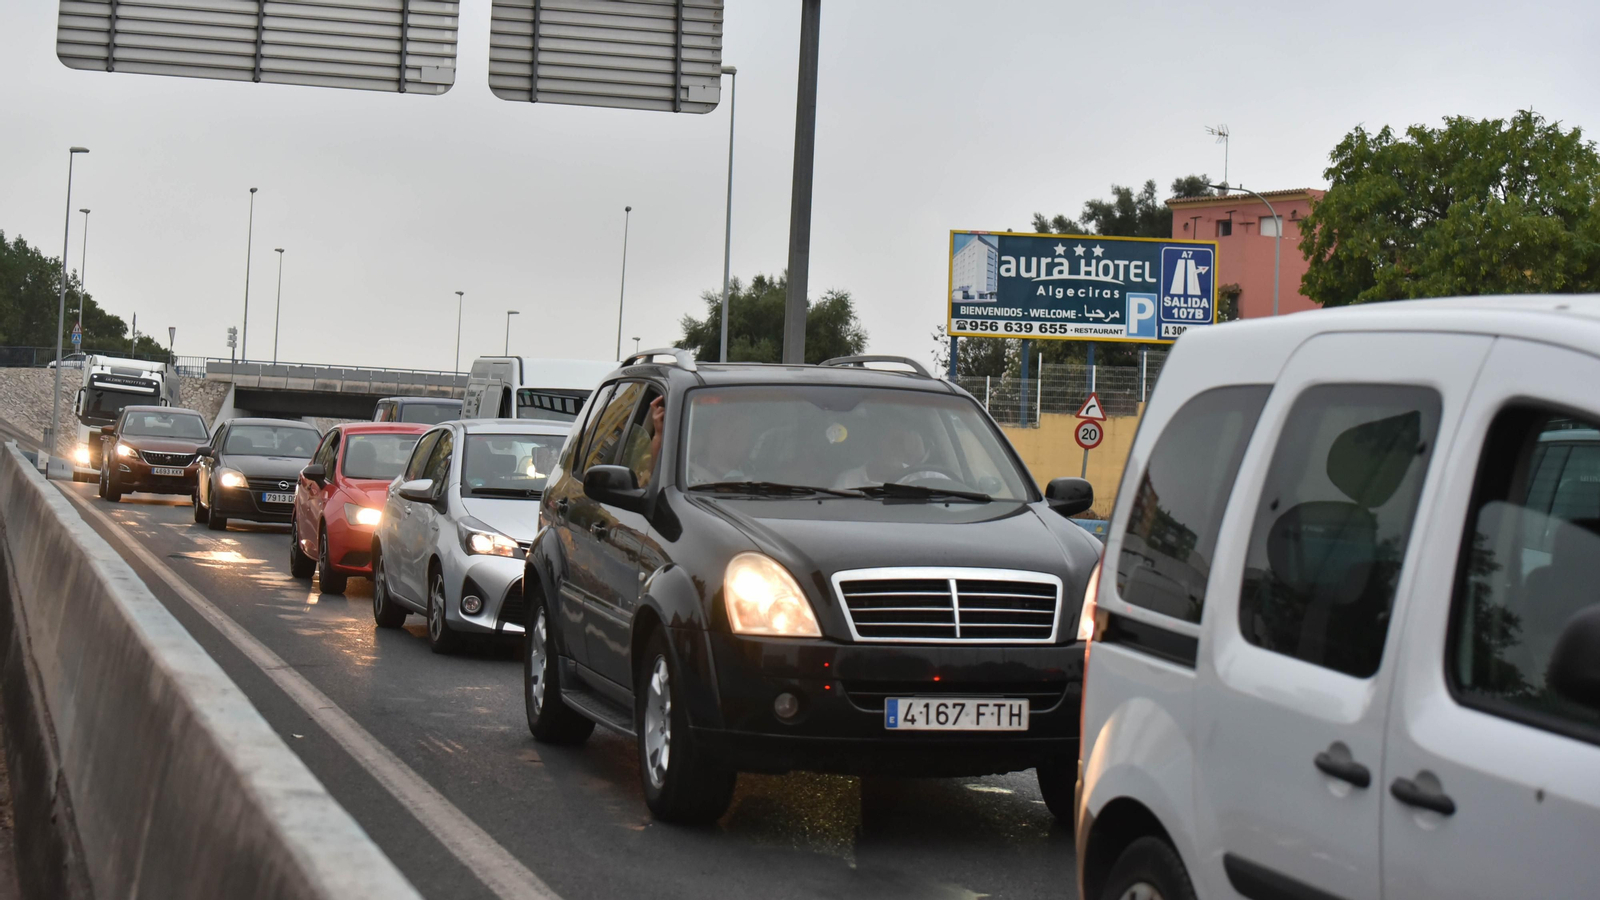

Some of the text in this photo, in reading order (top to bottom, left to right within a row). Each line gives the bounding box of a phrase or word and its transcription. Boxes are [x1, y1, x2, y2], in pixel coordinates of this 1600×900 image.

[1181, 250, 1193, 259] A7
[1000, 255, 1157, 282] aura HOTEL
[1036, 285, 1120, 299] Algeciras
[1163, 296, 1209, 308] SALIDA
[960, 306, 1022, 317] BIENVENIDOS
[1029, 308, 1076, 319] WELCOME
[1084, 304, 1120, 322] مرحبا
[1128, 297, 1155, 334] P
[1172, 308, 1204, 319] 107B
[969, 320, 1124, 335] 956 639 655 RESTAURANT
[1163, 325, 1170, 335] A
[1081, 427, 1097, 441] 20
[267, 494, 286, 502] 7913
[903, 702, 1022, 727] 4167 FTH
